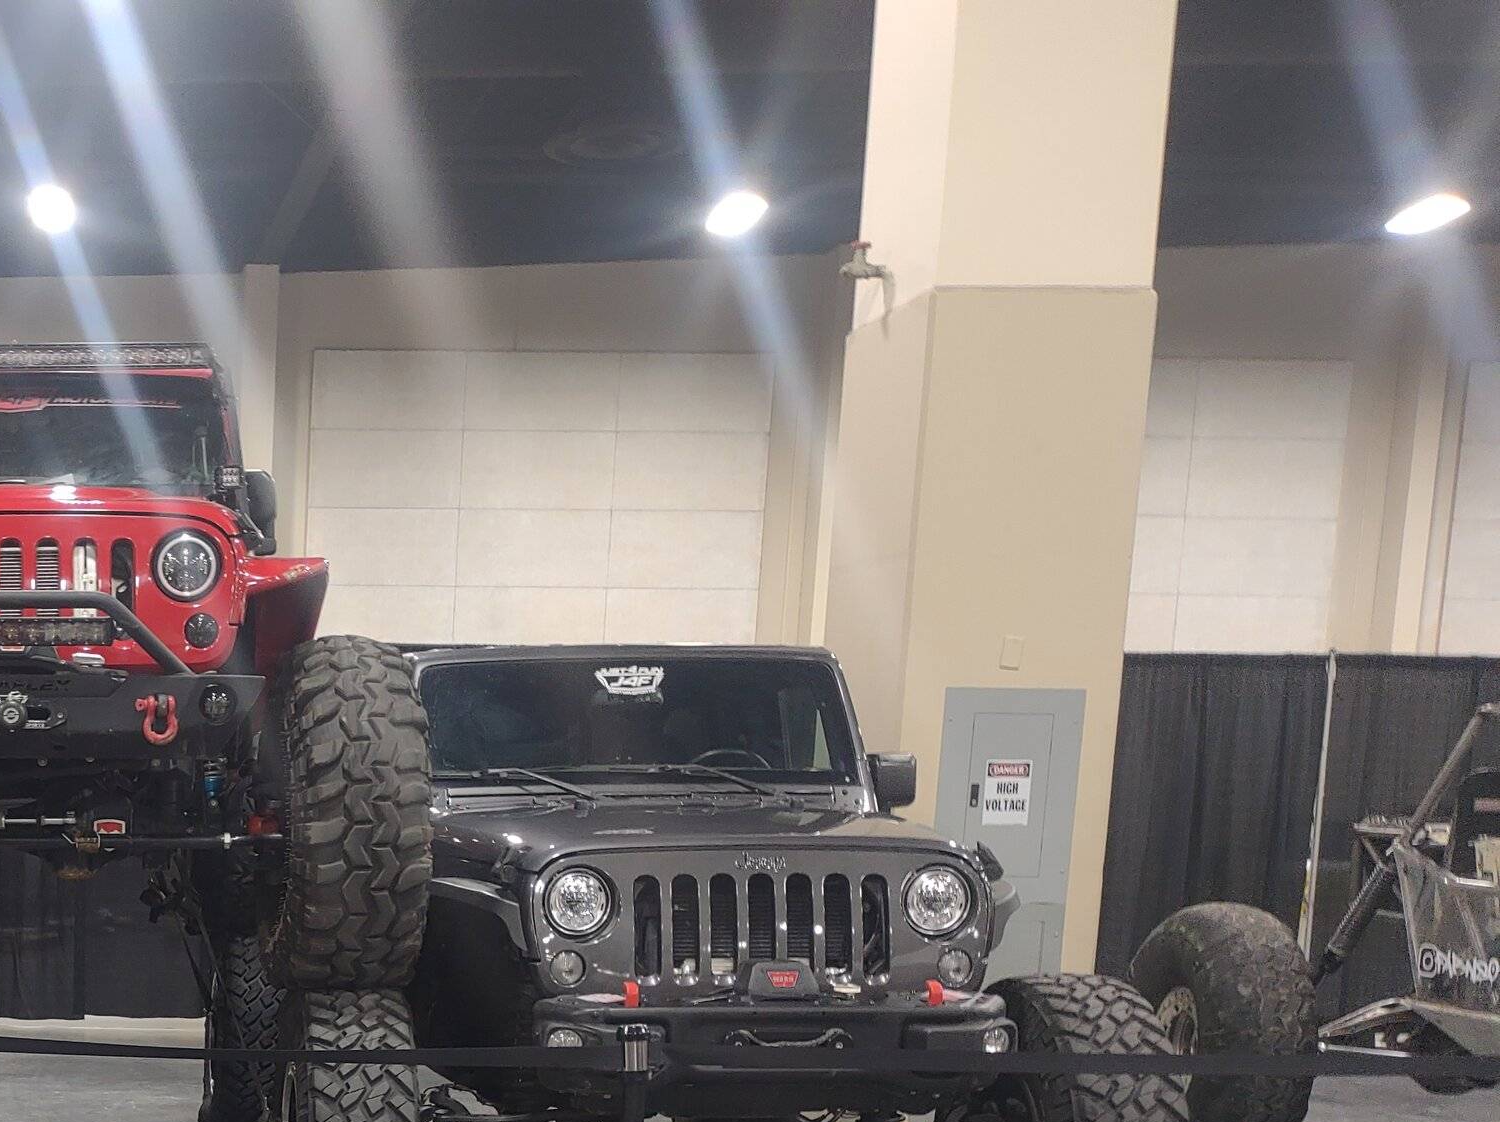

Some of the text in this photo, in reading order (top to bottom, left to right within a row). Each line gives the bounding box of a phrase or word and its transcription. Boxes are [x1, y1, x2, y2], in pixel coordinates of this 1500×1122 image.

[609, 677, 653, 687] J4F
[996, 782, 1019, 795] HIGH
[985, 799, 1027, 812] VOLTAGE
